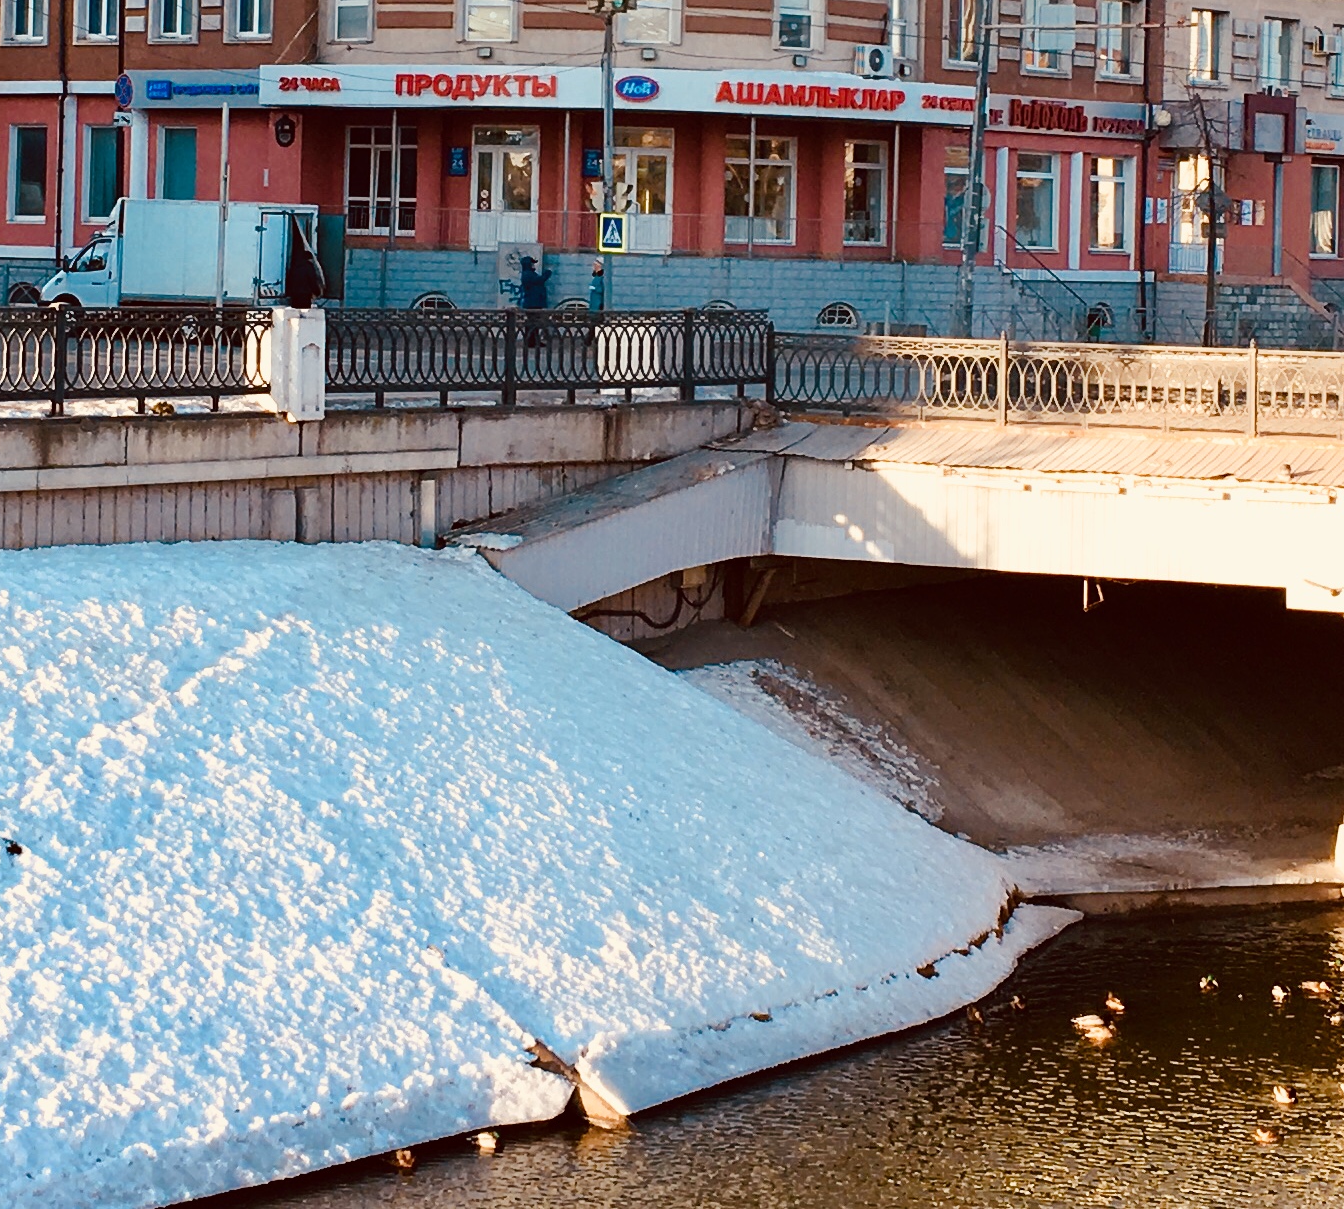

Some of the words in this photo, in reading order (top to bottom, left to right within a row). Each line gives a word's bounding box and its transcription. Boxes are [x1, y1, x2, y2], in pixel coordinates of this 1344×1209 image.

[279, 77, 298, 91] 24
[300, 78, 341, 92] ЧАСА
[395, 73, 558, 100] ПРОДУКТЫ
[715, 81, 905, 111] АШАМЛЫКЛАР
